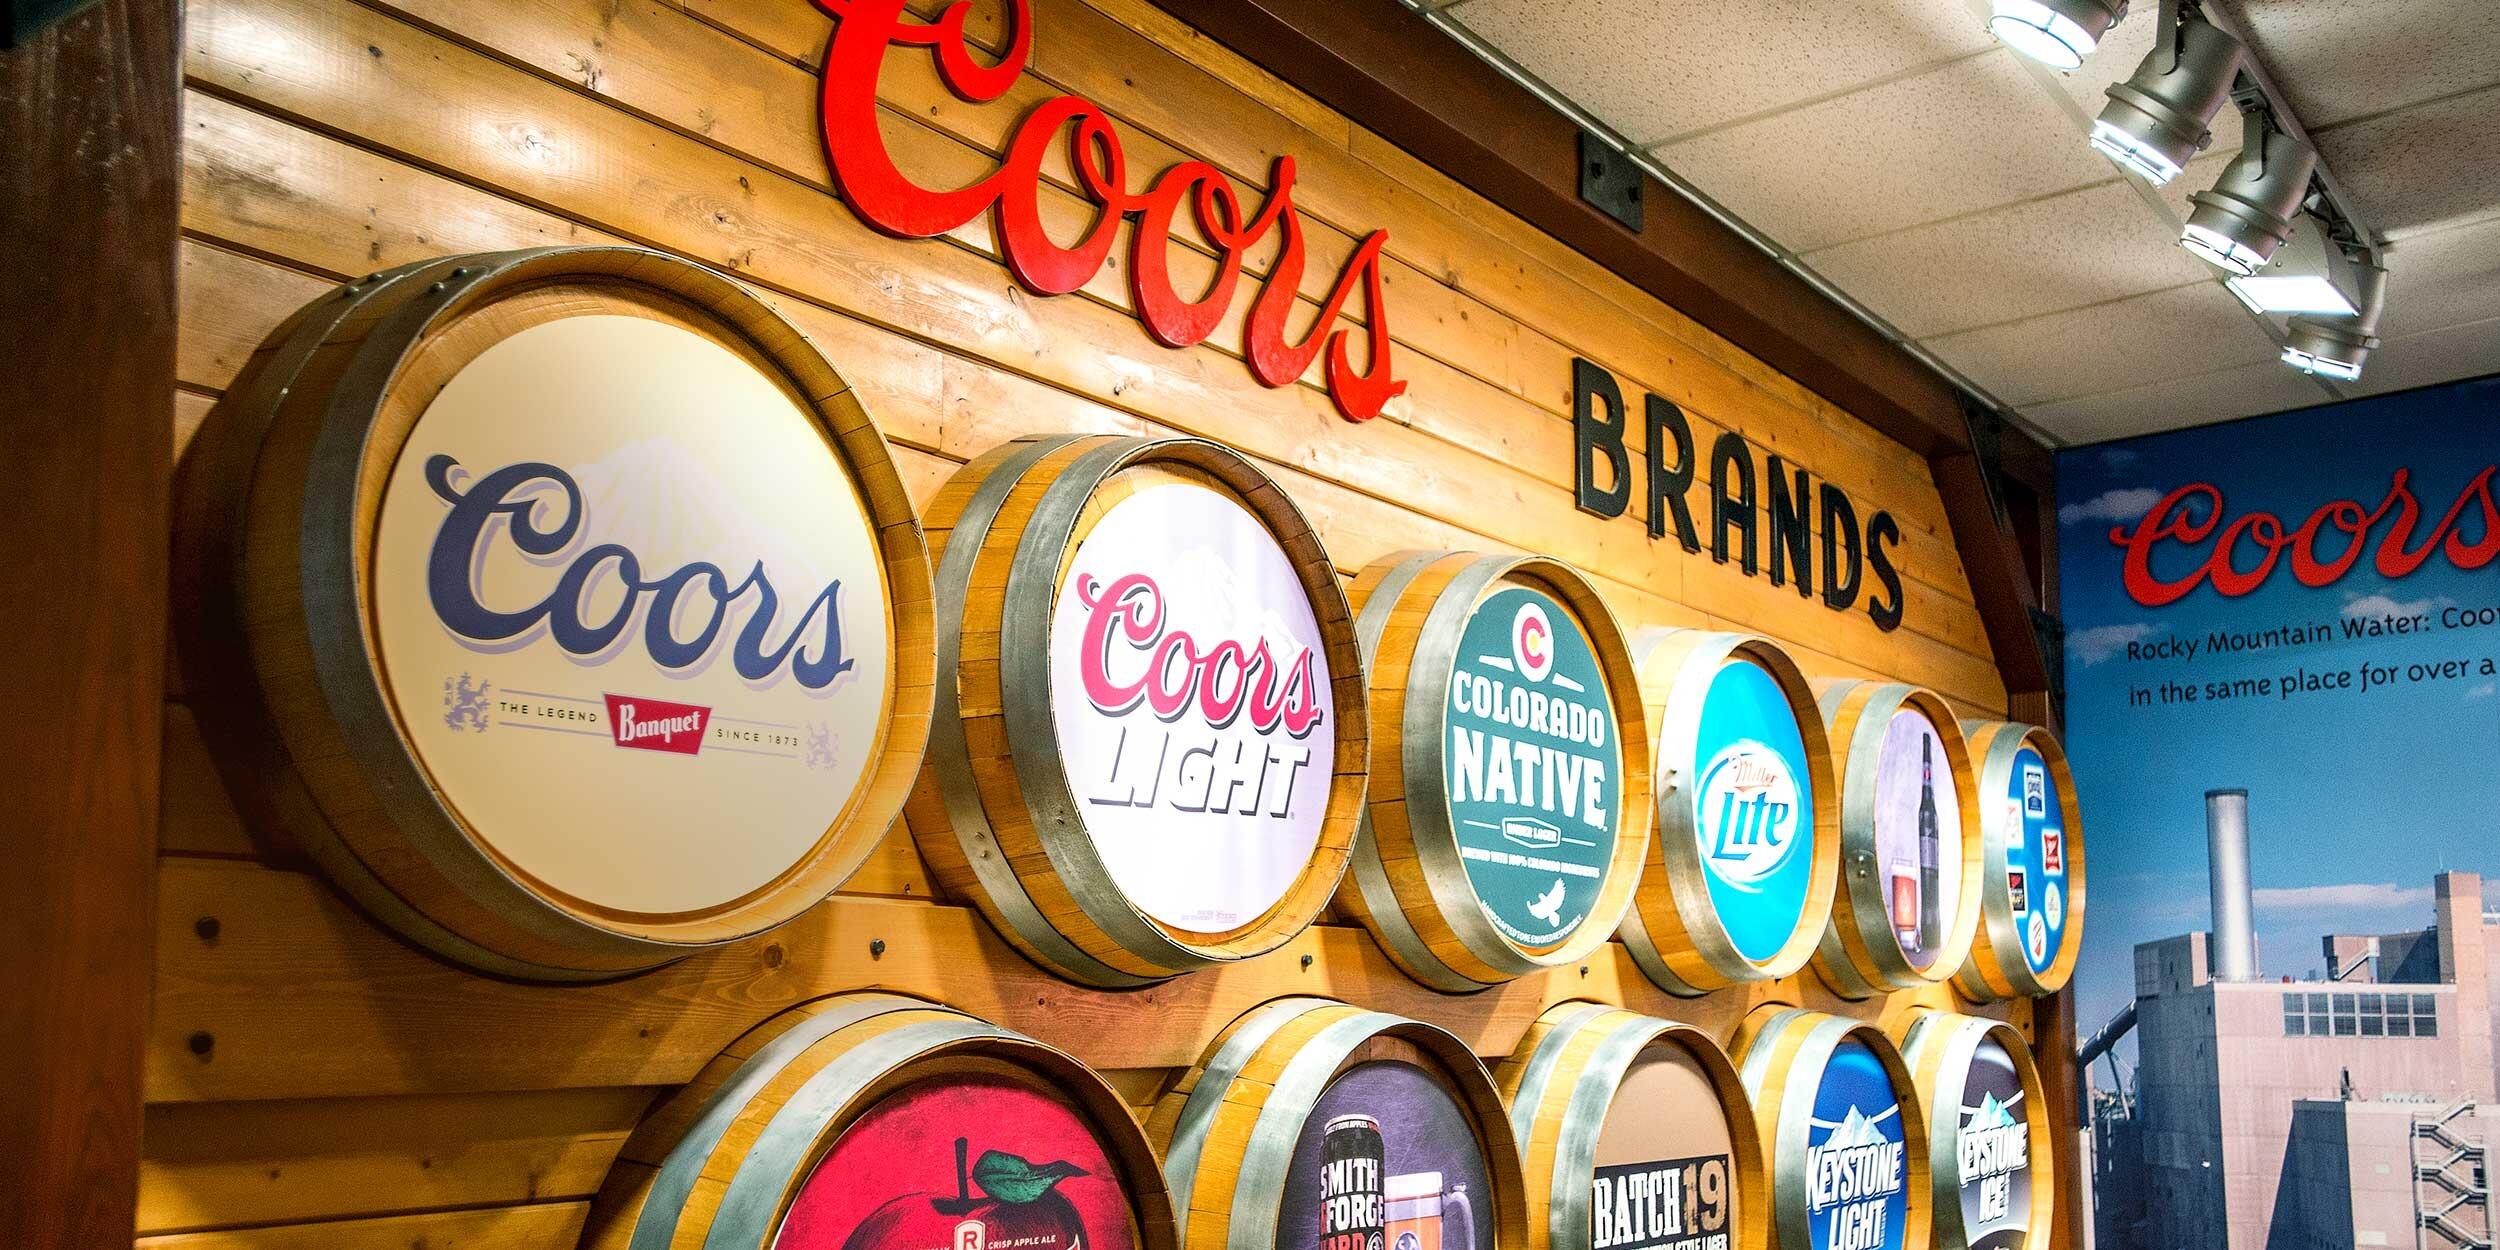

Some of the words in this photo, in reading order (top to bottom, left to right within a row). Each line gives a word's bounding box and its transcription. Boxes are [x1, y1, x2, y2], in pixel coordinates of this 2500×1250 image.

[814, 0, 1408, 423] Coors
[1572, 357, 1904, 633] BRANDS
[2109, 465, 2500, 606] Coors
[425, 454, 856, 692] Coors
[1077, 573, 1321, 736] Coors
[2127, 636, 2197, 663] Rocky
[2207, 621, 2332, 654] Mountain
[2340, 612, 2430, 640] Water:
[2441, 606, 2500, 629] Coo
[500, 702, 529, 715] THE
[538, 706, 597, 722] LEGEND
[1453, 669, 1606, 748] COLORADO
[2130, 685, 2151, 707] in
[2160, 678, 2198, 703] the
[2205, 674, 2271, 700] same
[2280, 667, 2351, 700] place
[2359, 661, 2399, 692] for
[2407, 657, 2470, 682] over
[2479, 657, 2496, 676] a
[619, 703, 701, 744] Banquet
[716, 728, 760, 742] SINCE
[769, 734, 799, 747] 1873
[1089, 727, 1311, 819] LIGHT
[1712, 792, 1789, 860] Lite
[1320, 1157, 1379, 1200] SMITH
[1806, 1141, 1905, 1215] KEYSTONE
[1957, 1121, 2028, 1188] KEYSTONE
[1326, 1193, 1384, 1234] FORGE
[1592, 1167, 1682, 1250] BATCH
[1683, 1160, 1727, 1236] 19
[1829, 1198, 1886, 1250] LIGHT
[1979, 1172, 2008, 1224] ICE
[988, 1239, 1012, 1250] CRISP
[1014, 1237, 1039, 1246] APPLE
[1041, 1235, 1056, 1244] ALE
